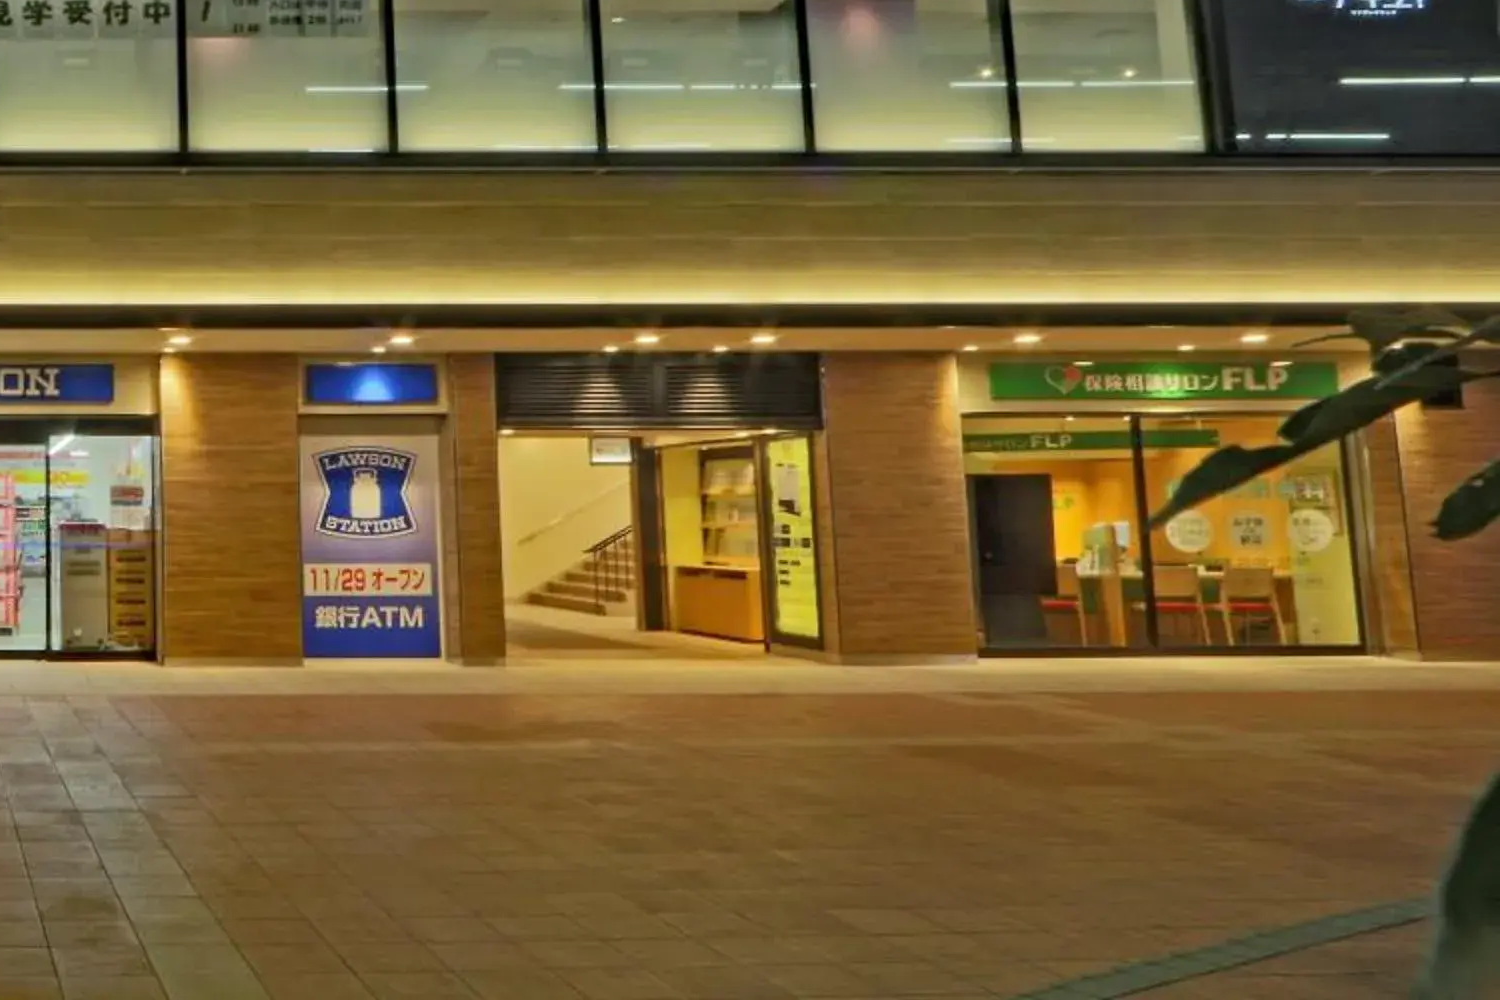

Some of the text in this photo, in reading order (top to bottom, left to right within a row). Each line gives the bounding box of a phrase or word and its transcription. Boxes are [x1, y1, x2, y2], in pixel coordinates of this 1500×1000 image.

[323, 453, 406, 471] LAWSON
[326, 515, 407, 534] STATION
[310, 567, 425, 592] 11/29 オープン
[314, 605, 424, 629] 銀行ATM
